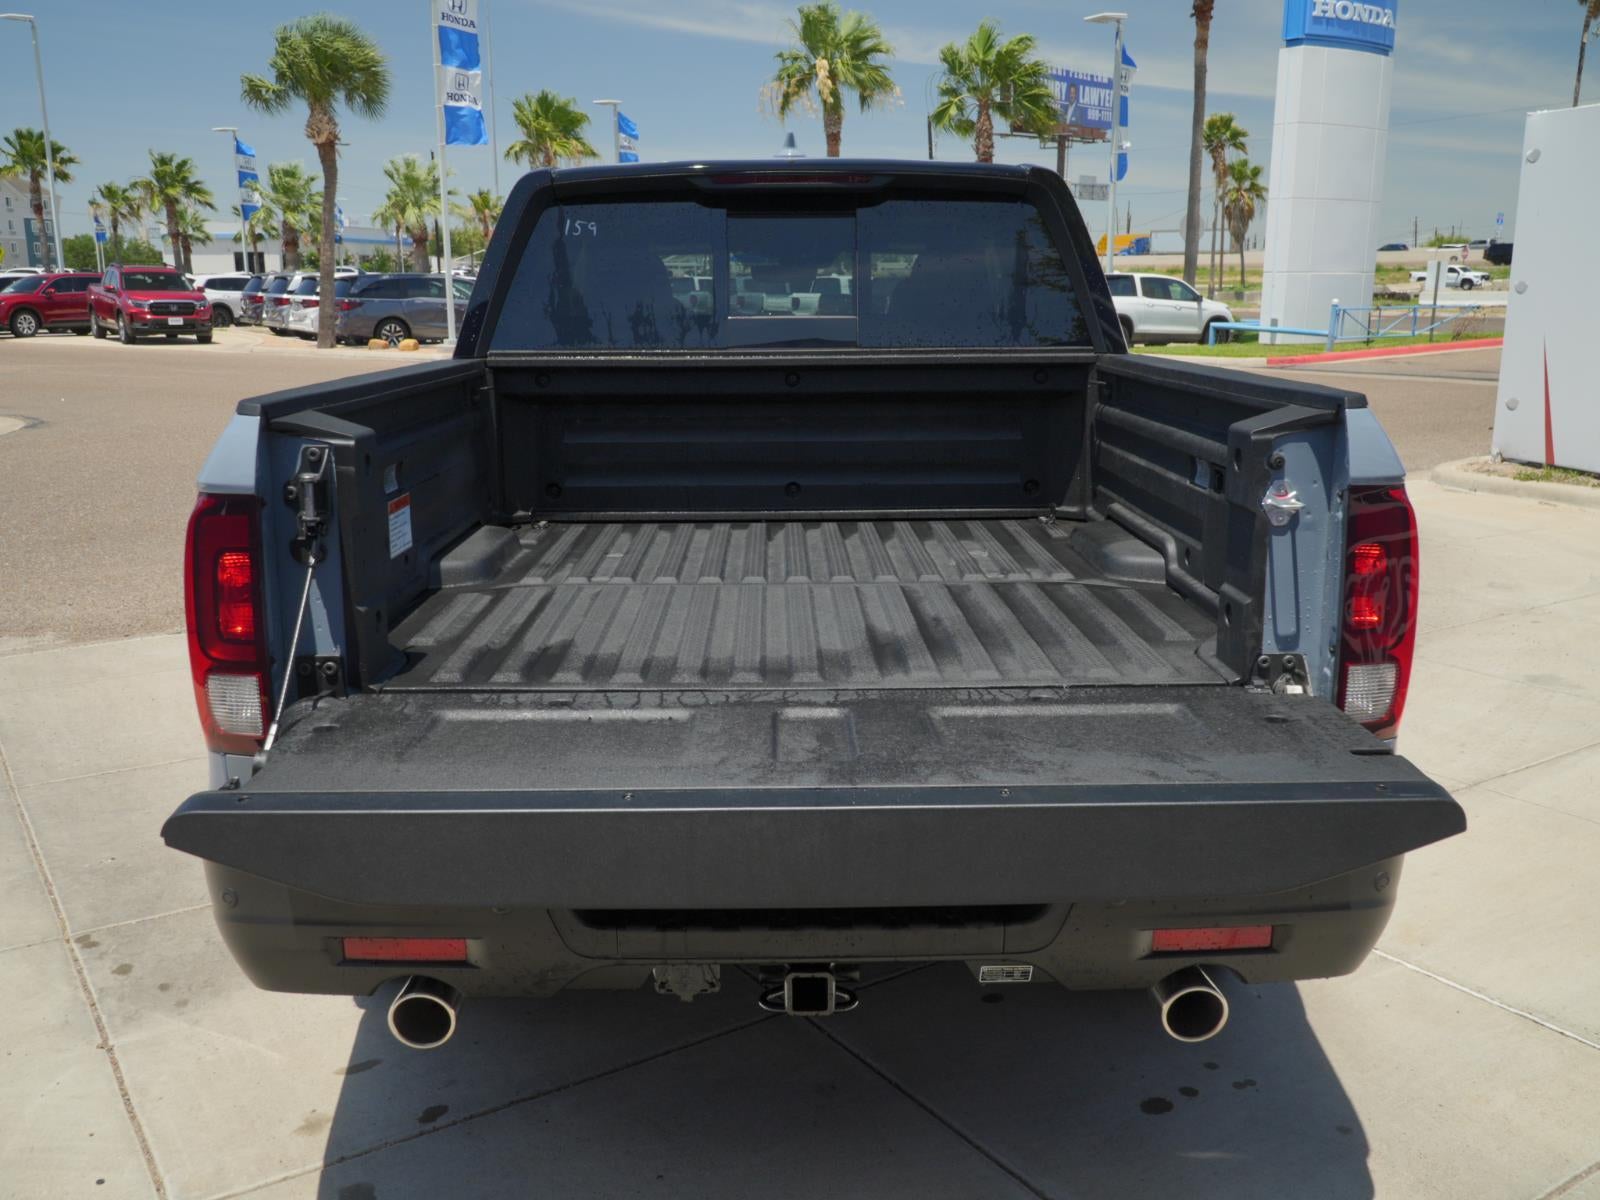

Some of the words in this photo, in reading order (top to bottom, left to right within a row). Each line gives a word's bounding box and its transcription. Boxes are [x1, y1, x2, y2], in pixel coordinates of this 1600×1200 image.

[441, 12, 476, 29] HONDA
[1312, 0, 1396, 29] HONDA
[565, 219, 597, 236] 159
